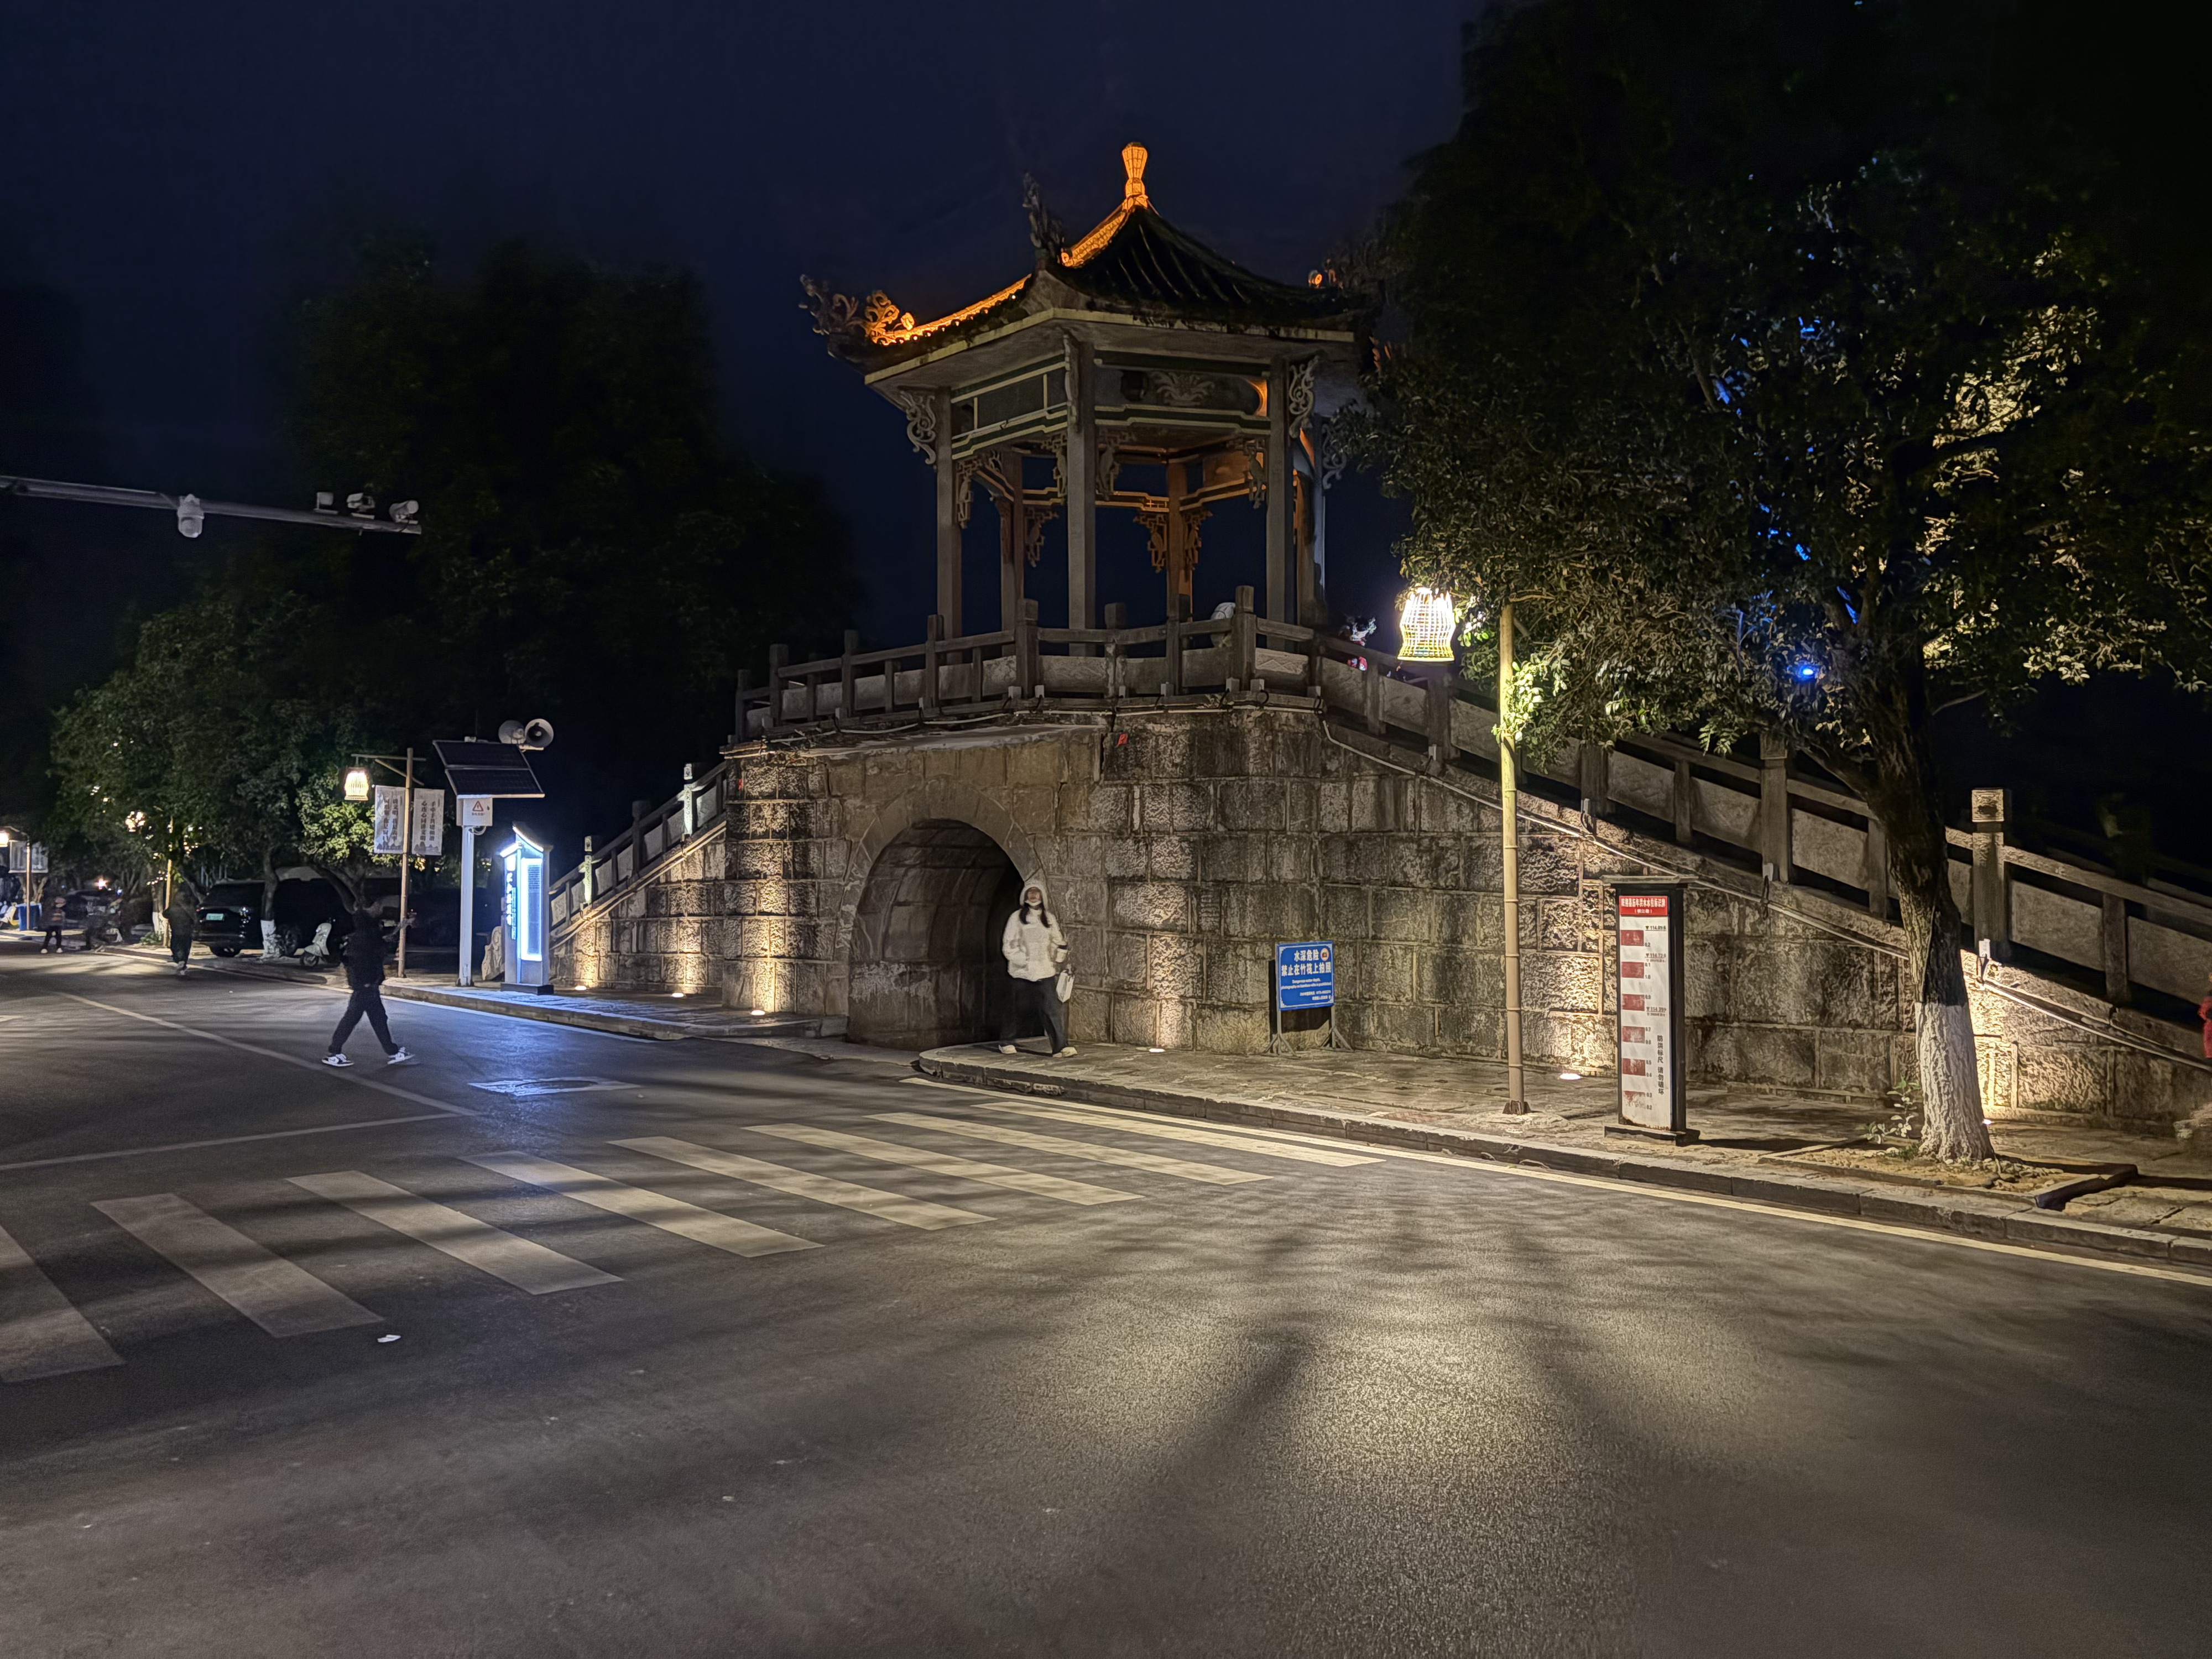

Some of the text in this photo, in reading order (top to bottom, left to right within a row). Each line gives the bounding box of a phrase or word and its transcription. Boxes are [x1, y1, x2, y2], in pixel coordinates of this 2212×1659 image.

[1294, 949, 1319, 962] 水深危险
[1281, 961, 1332, 977] 禁止在竹筏上拍照
